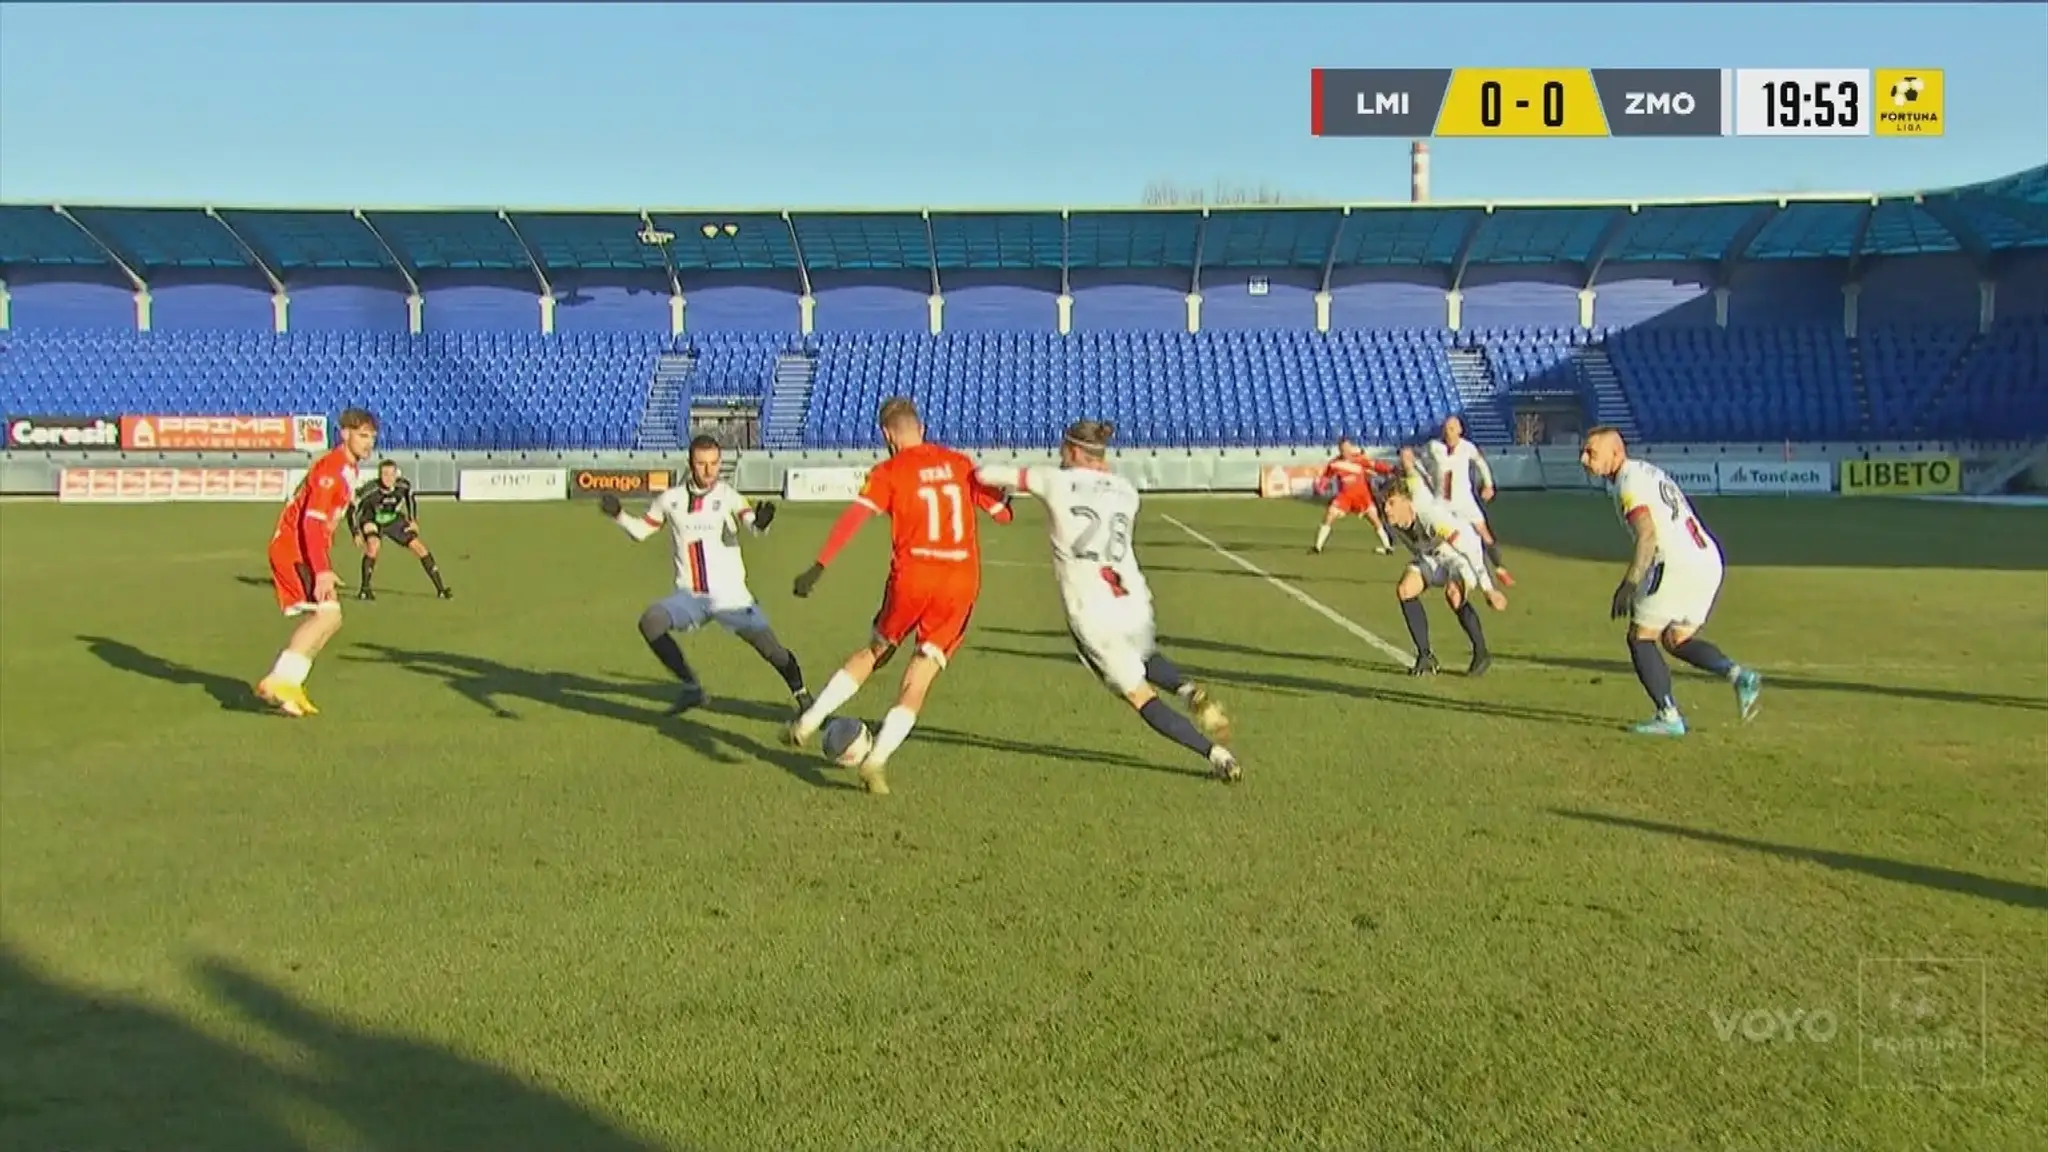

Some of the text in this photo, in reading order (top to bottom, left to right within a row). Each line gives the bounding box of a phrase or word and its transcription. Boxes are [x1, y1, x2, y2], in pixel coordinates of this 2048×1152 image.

[578, 472, 641, 491] Orange
[1750, 469, 1820, 483] Tondach
[1850, 461, 1951, 487] LIBETO
[917, 484, 964, 543] 11
[1070, 506, 1129, 562] 28
